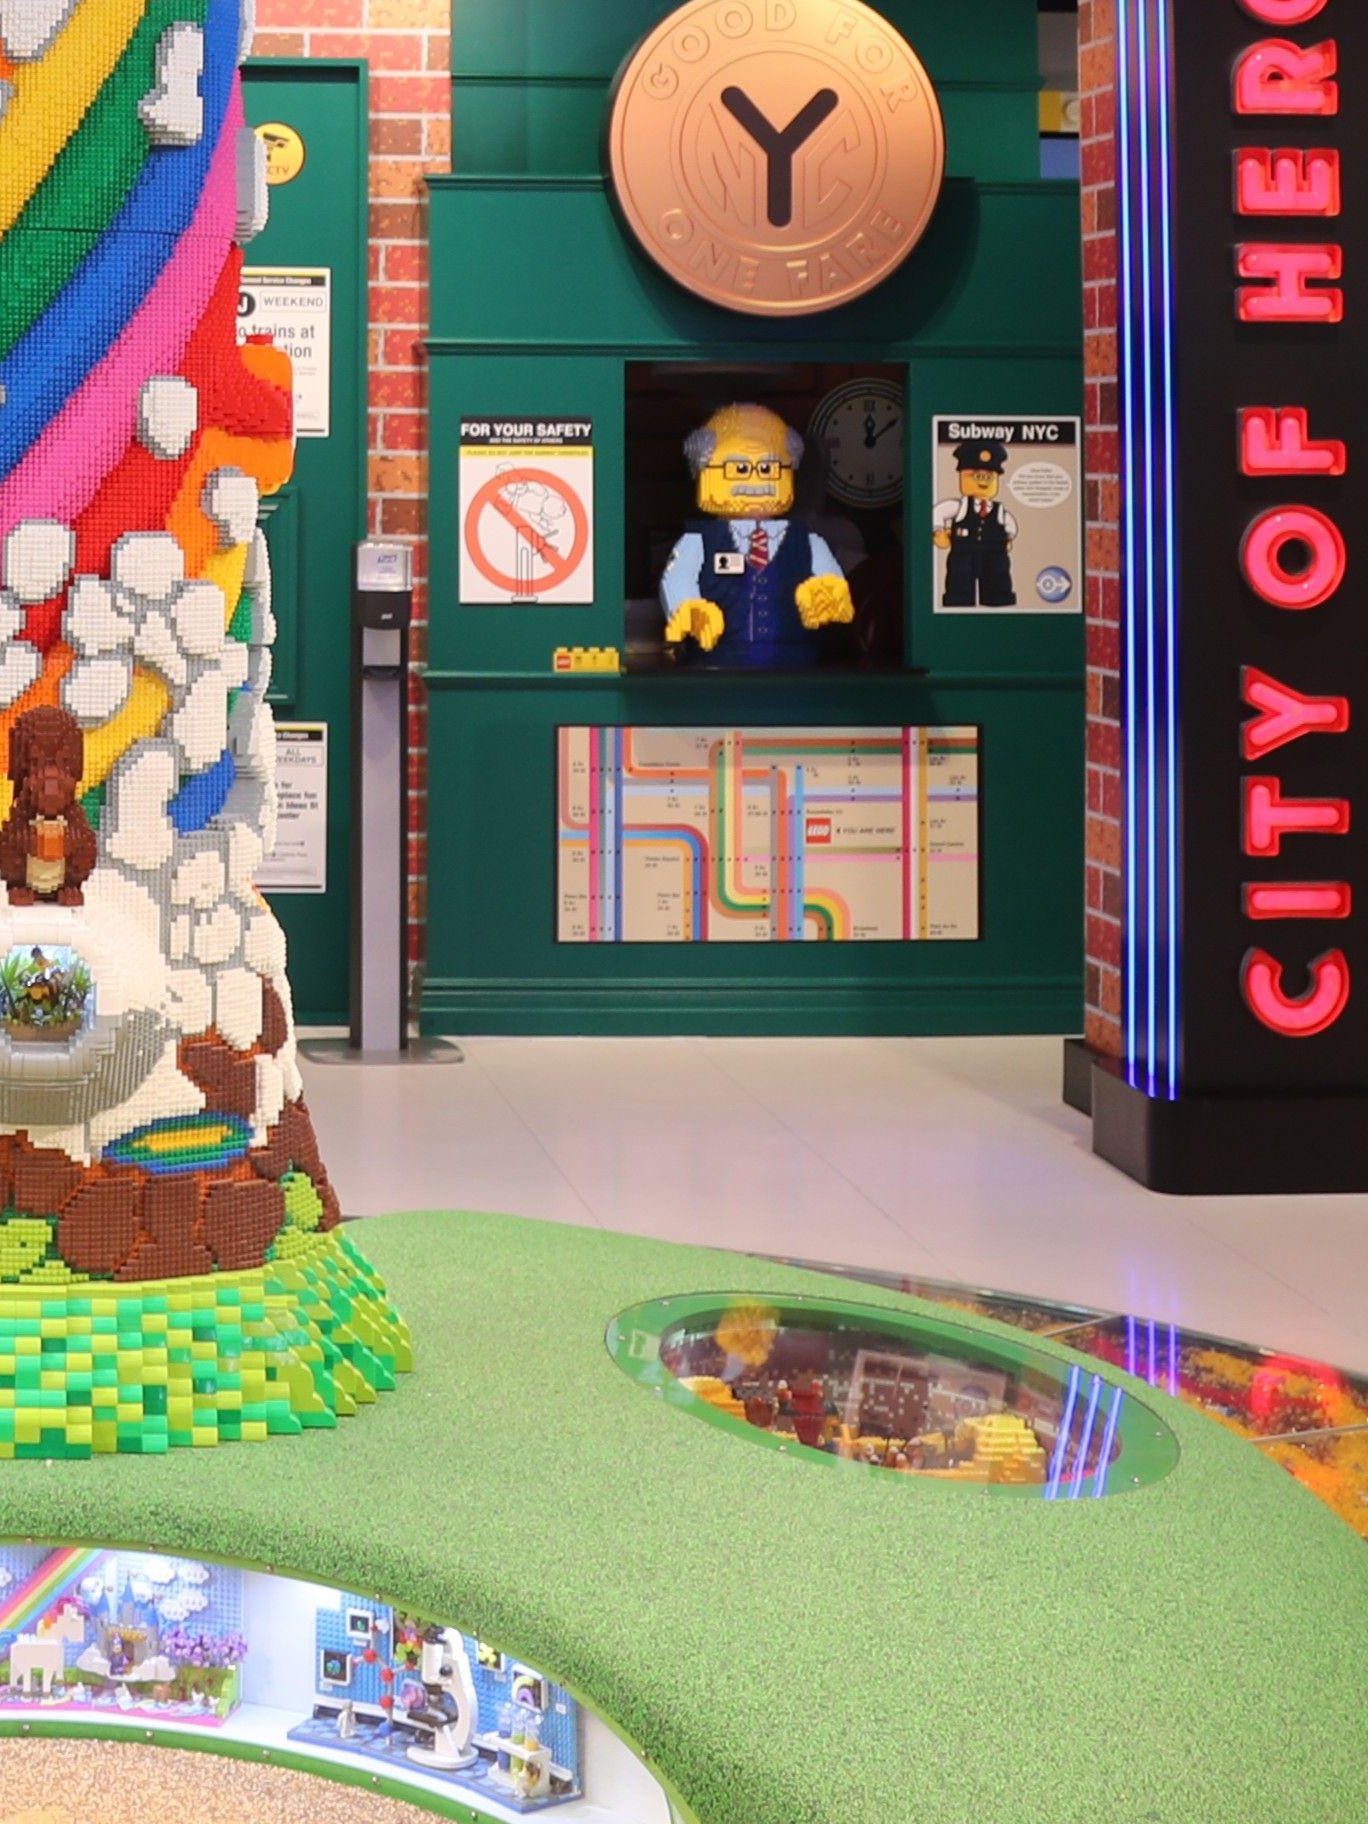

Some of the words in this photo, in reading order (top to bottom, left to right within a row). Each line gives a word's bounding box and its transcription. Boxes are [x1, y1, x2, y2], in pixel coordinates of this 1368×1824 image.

[824, 9, 918, 113] FOR
[267, 166, 289, 175] CTV
[661, 208, 760, 292] ONE
[786, 209, 905, 295] FARE
[264, 297, 323, 307] WEEKEND
[300, 325, 315, 339] at
[461, 423, 490, 436] FOR
[493, 423, 534, 436] YOUR
[536, 423, 591, 436] SAFETY
[948, 422, 1014, 442] Subway
[1022, 424, 1059, 441] NYC
[1241, 406, 1347, 610] OF
[277, 756, 316, 764] EEKDAYS
[1241, 664, 1351, 1037] CITY
